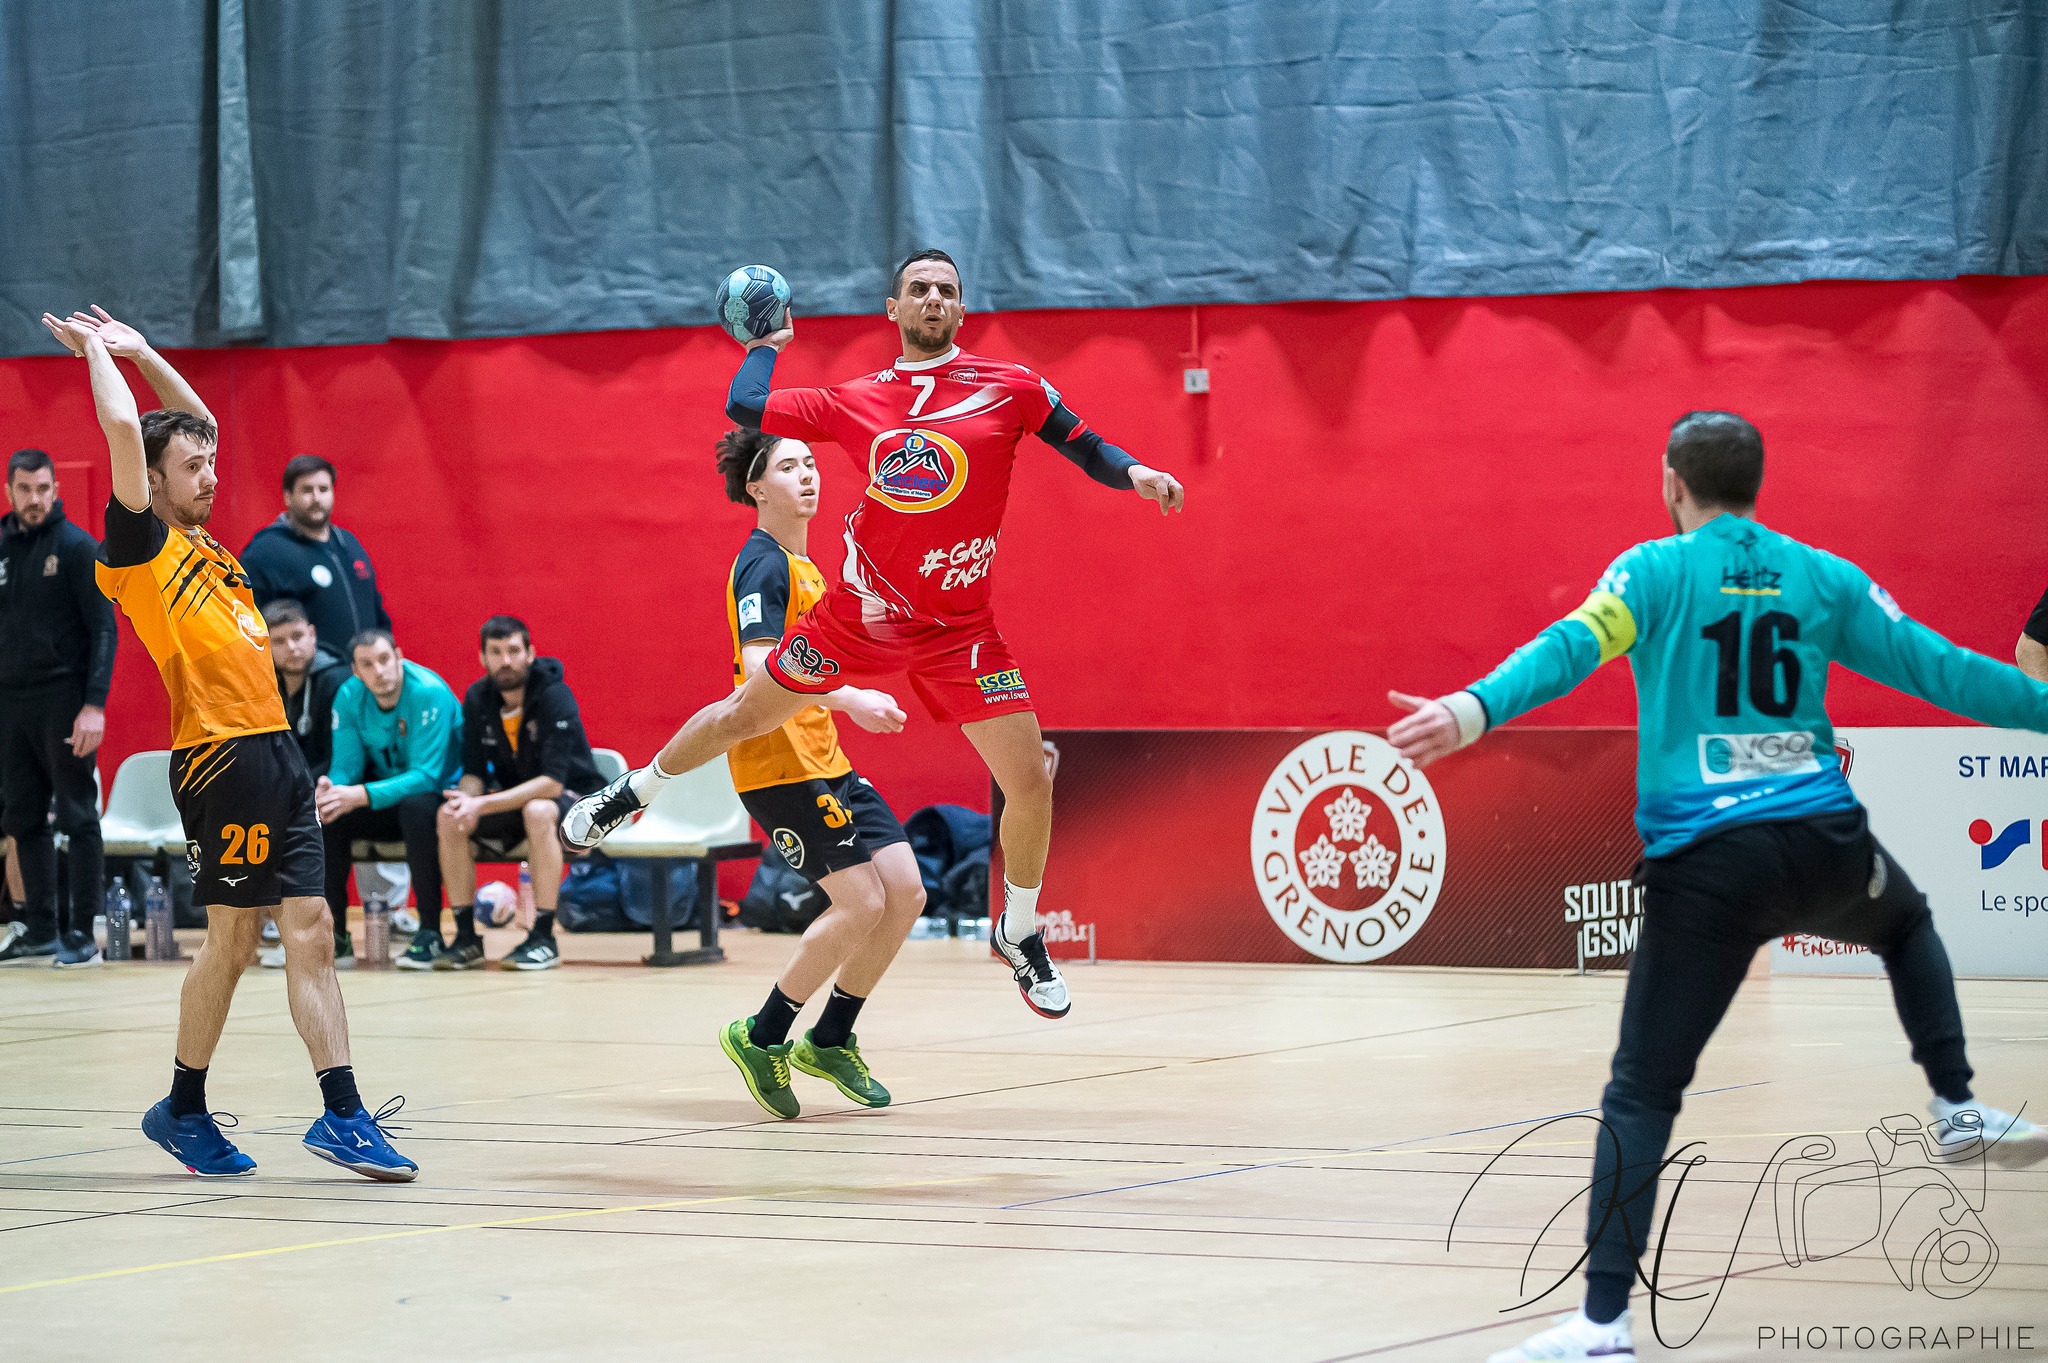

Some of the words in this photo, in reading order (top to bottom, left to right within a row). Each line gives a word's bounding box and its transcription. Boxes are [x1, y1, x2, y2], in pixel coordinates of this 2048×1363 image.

[908, 375, 936, 417] 7
[1701, 610, 1800, 719] 16
[1266, 744, 1367, 815] VILLE
[1381, 763, 1429, 824] DE
[1958, 756, 1991, 778] ST
[220, 823, 270, 865] 26
[1263, 850, 1435, 951] GRENOBLE
[1981, 889, 2007, 911] Le
[1583, 917, 1644, 958] GSM
